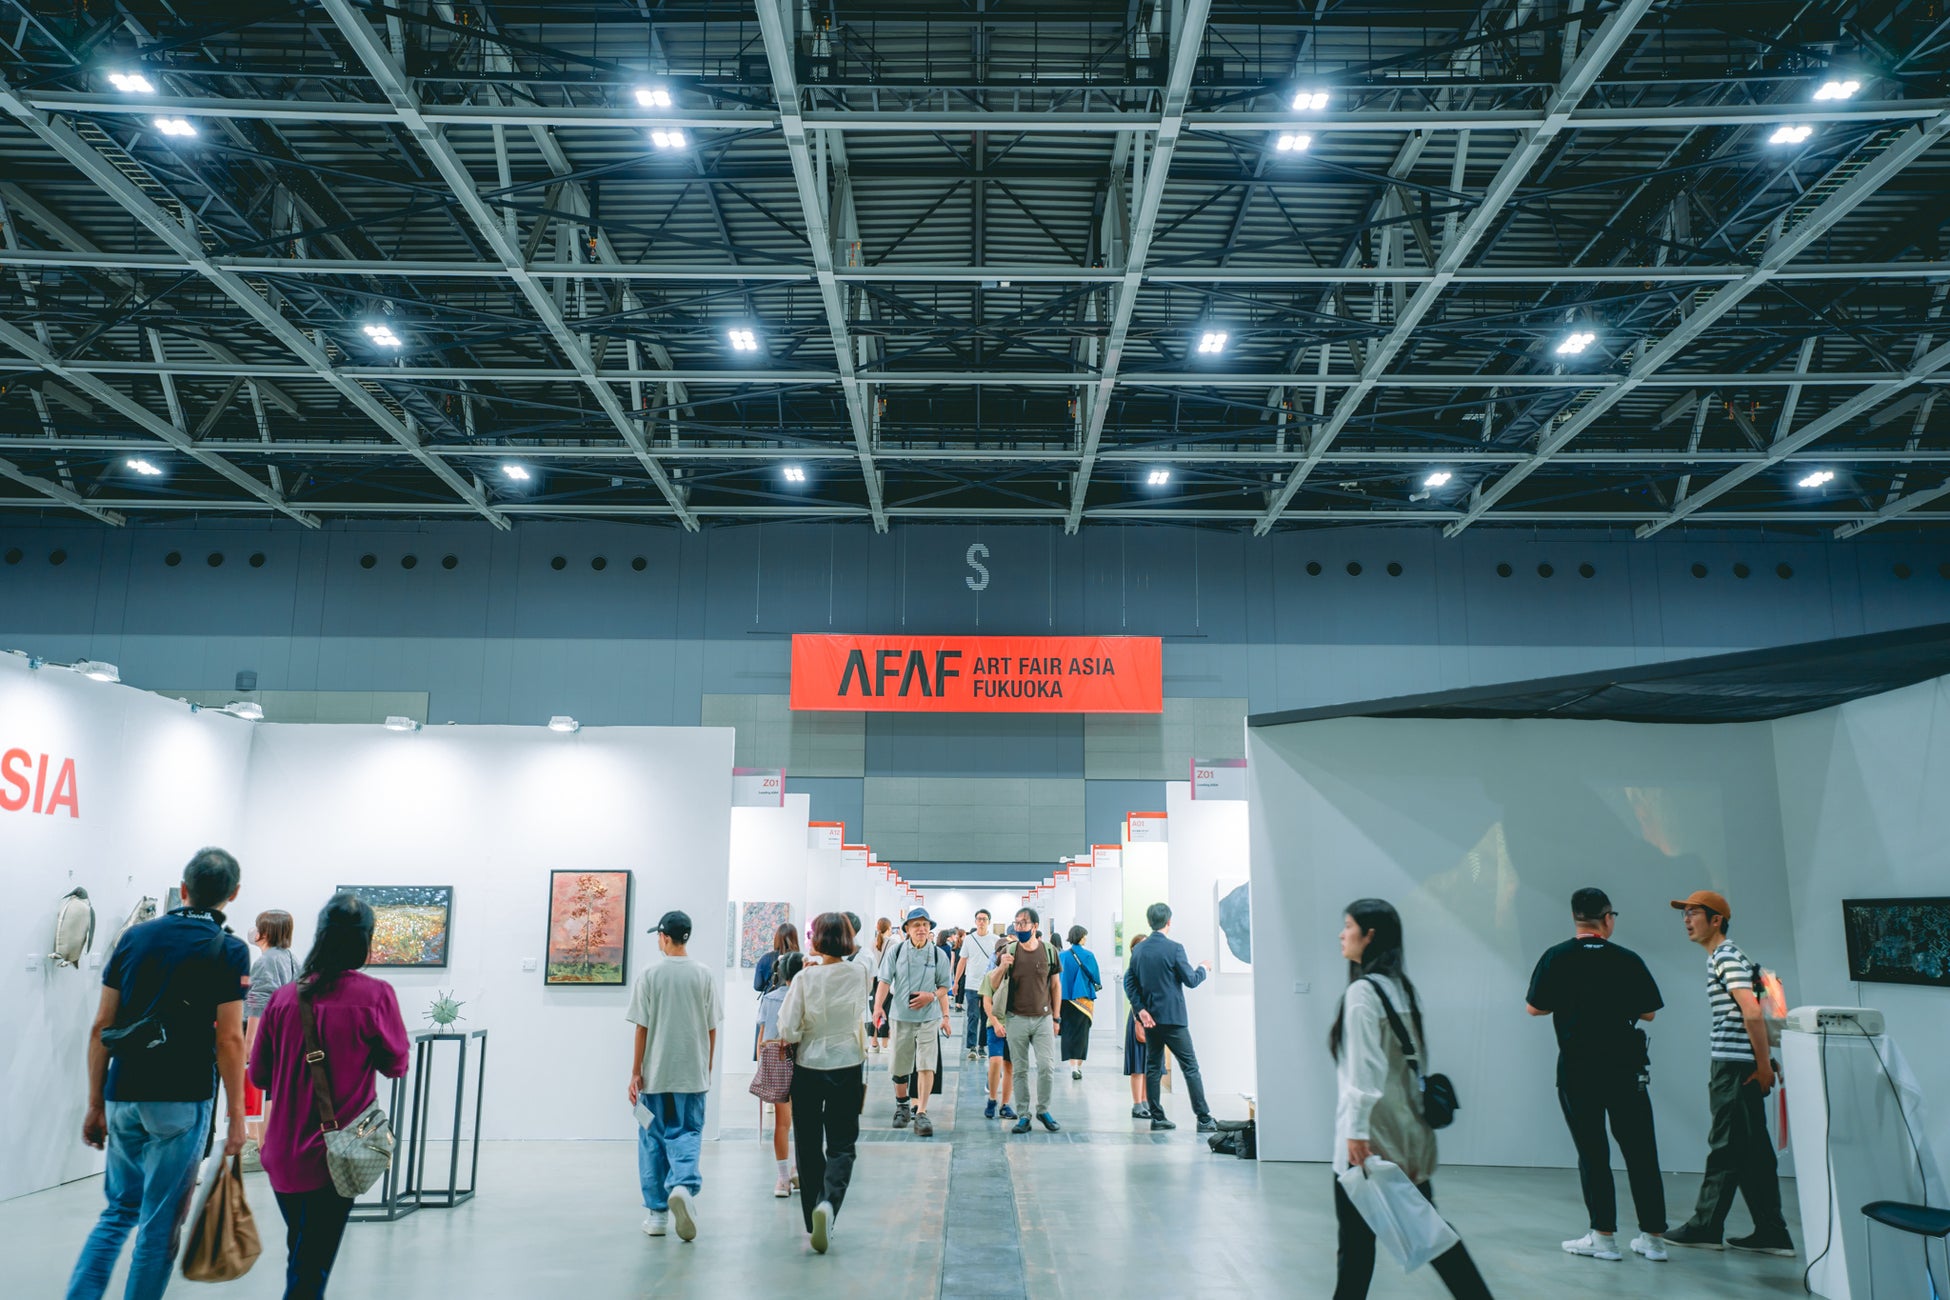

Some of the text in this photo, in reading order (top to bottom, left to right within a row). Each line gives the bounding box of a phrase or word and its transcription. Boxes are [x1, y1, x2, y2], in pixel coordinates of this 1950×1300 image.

[965, 543, 990, 591] S
[837, 649, 962, 697] AFAF
[973, 657, 1115, 676] ART FAIR ASIA
[973, 679, 1063, 698] FUKUOKA
[763, 779, 779, 787] Z01
[1197, 770, 1214, 778] Z01
